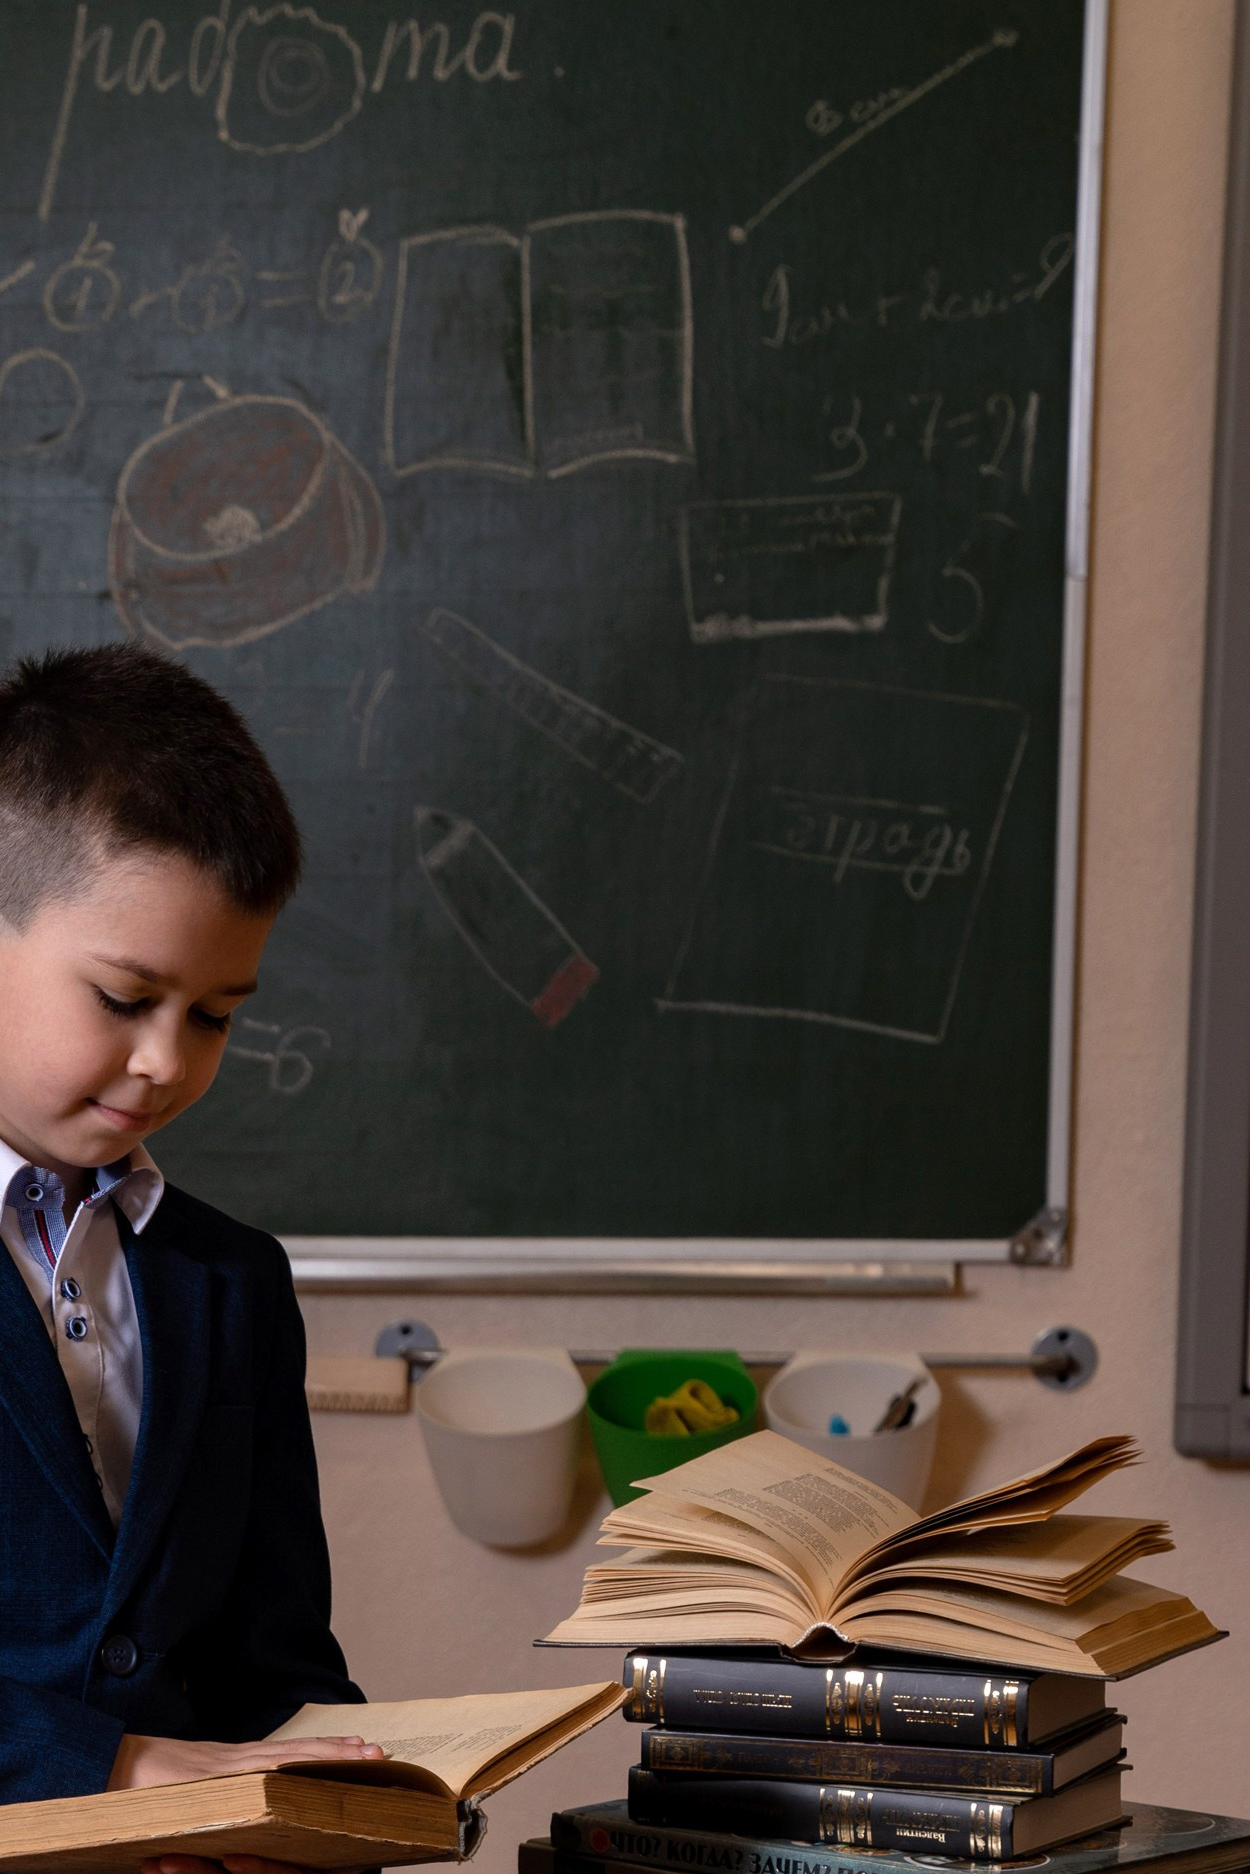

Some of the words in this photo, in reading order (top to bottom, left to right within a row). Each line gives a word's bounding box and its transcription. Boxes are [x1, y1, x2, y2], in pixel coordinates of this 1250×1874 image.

[896, 1828, 947, 1844] Валентин
[611, 1833, 662, 1858] ЧТО?
[667, 1839, 745, 1871] КОГДА?
